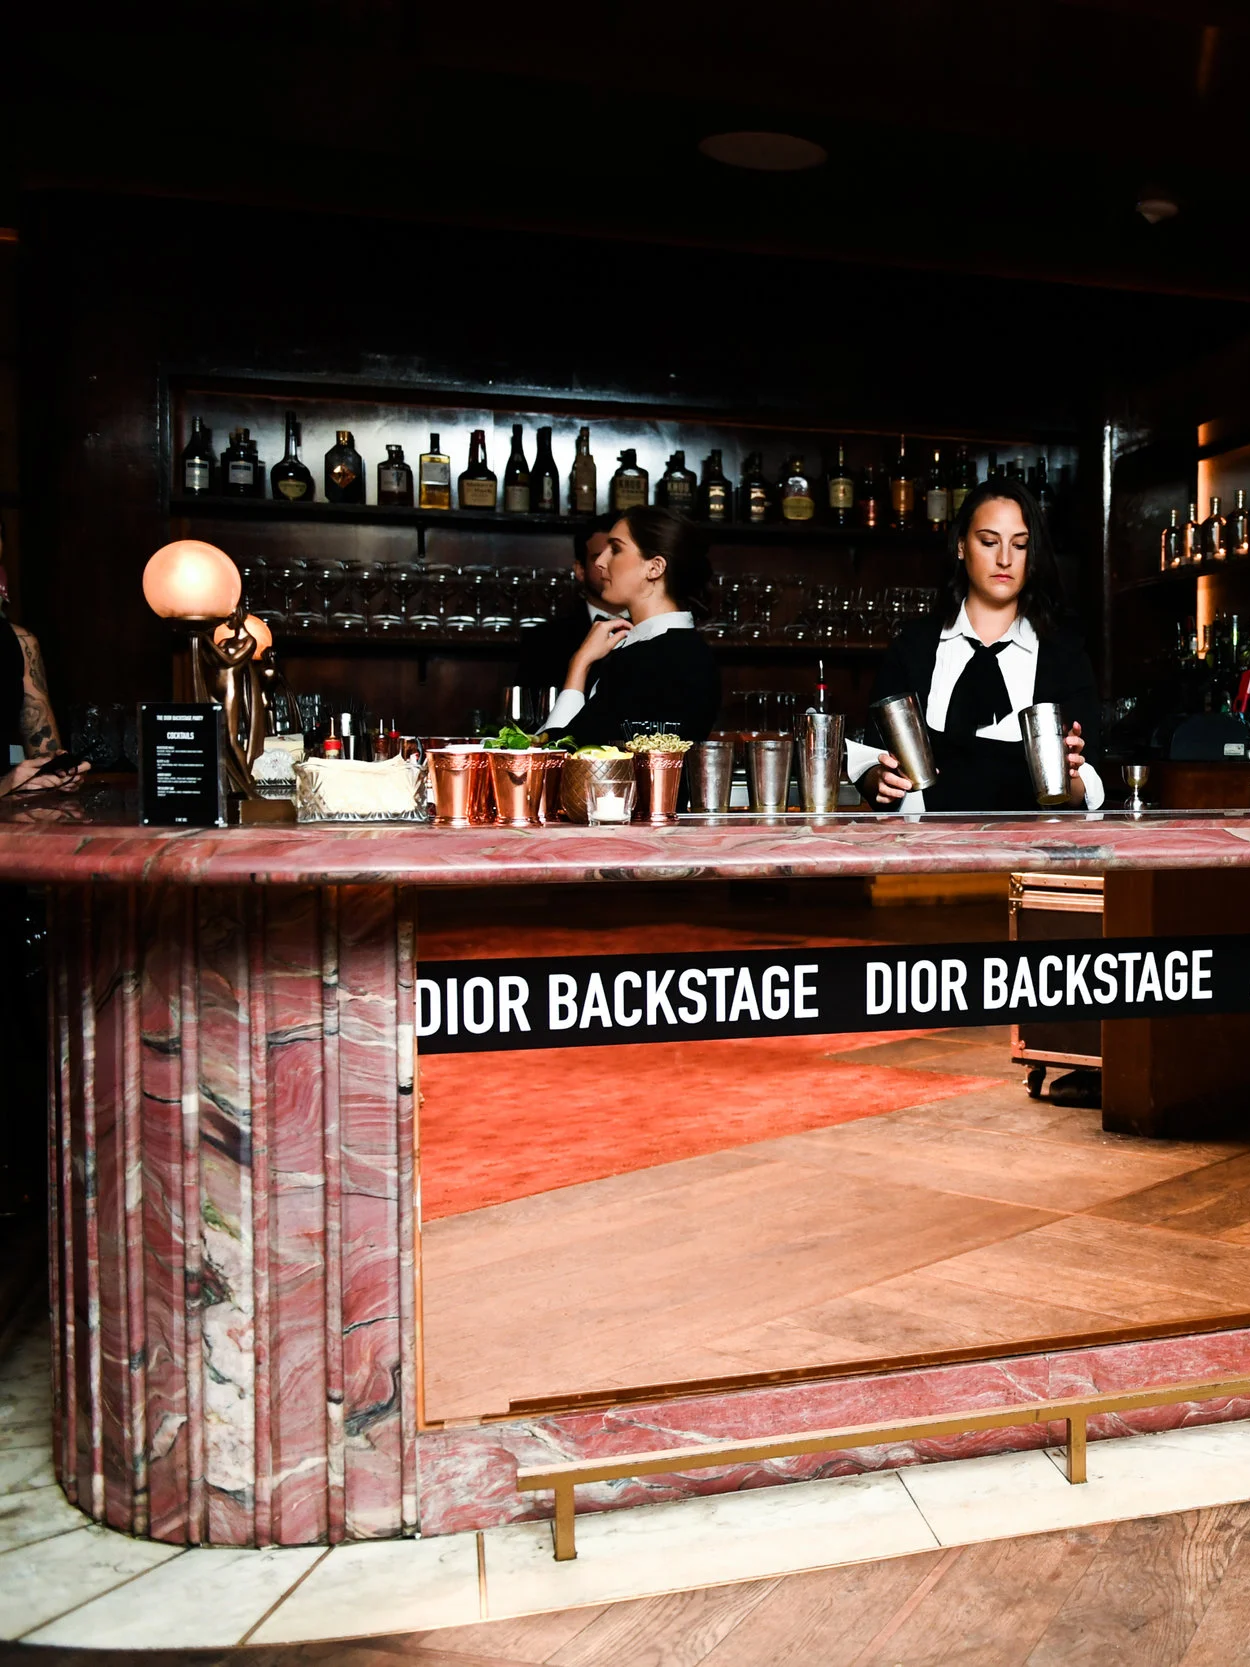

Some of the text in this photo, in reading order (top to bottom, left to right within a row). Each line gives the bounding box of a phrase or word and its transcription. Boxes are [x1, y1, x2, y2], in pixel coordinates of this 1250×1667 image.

[167, 731, 195, 740] COCKTAILS
[416, 976, 532, 1037] DIOR
[549, 964, 819, 1030] BACKSTAGE
[867, 959, 969, 1015] DIOR
[984, 949, 1213, 1009] BACKSTAGE
